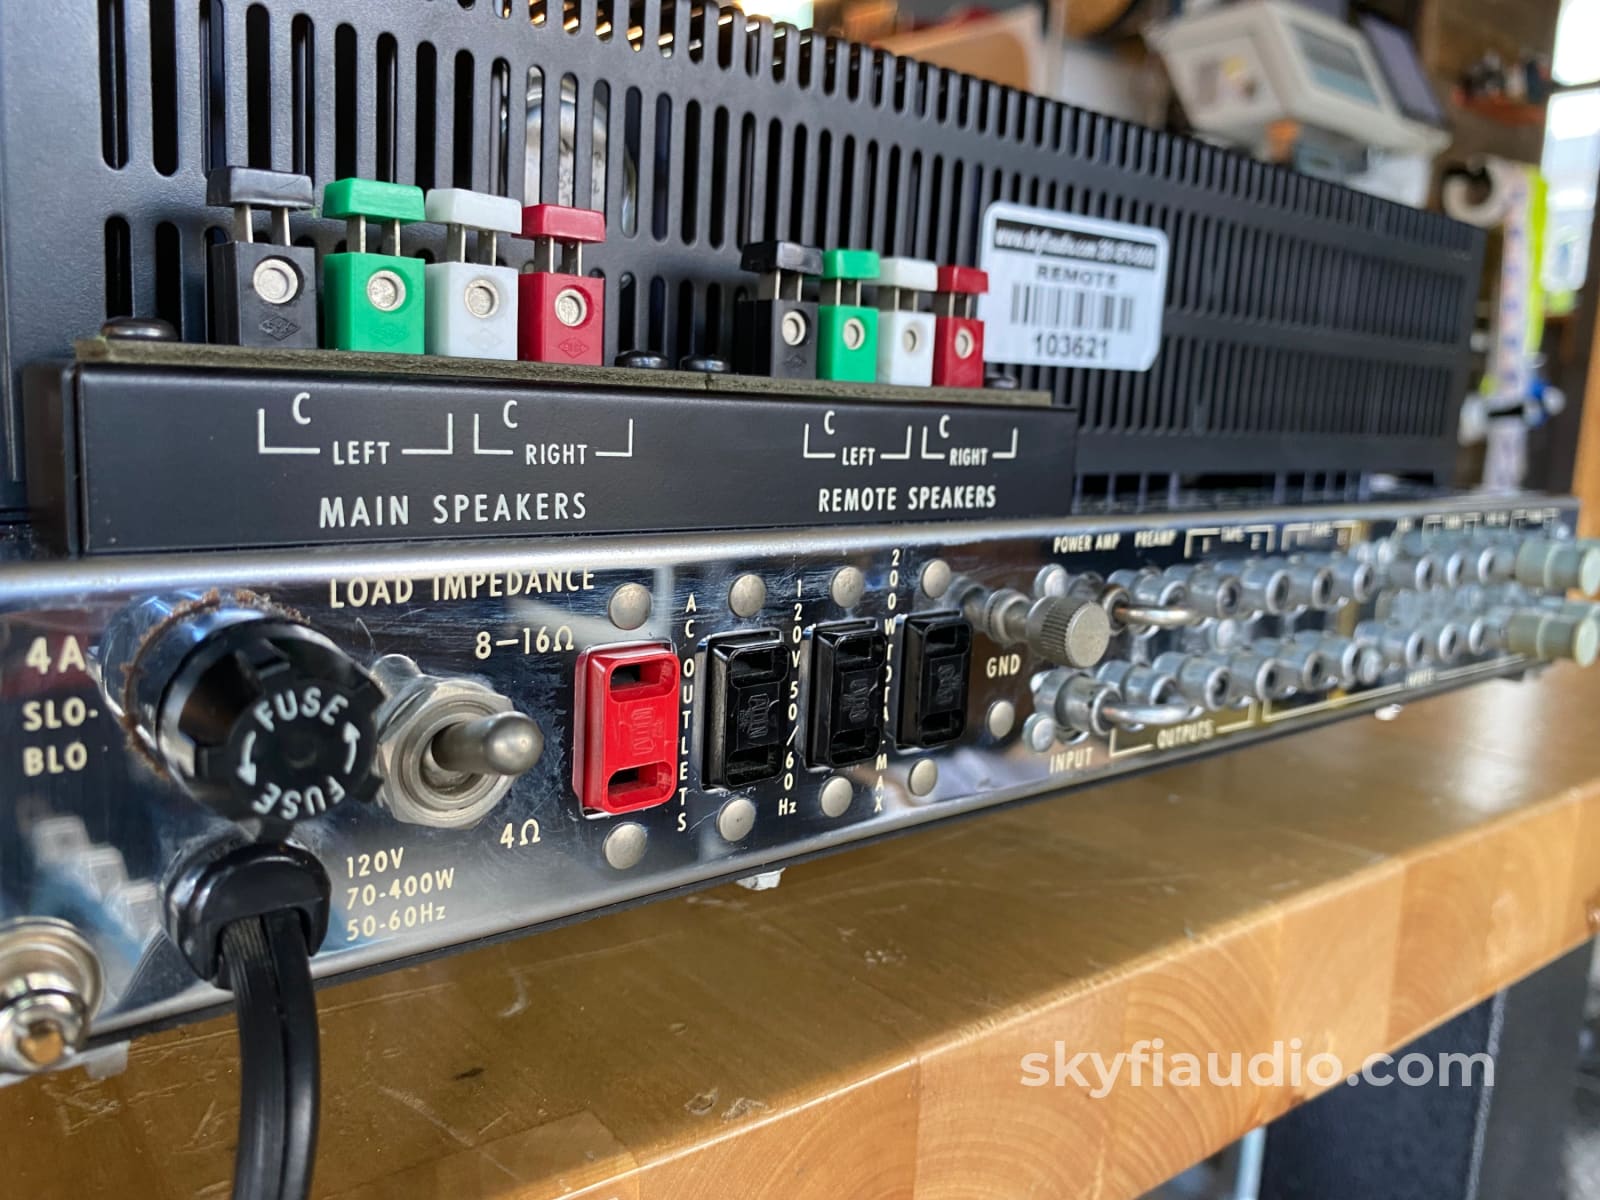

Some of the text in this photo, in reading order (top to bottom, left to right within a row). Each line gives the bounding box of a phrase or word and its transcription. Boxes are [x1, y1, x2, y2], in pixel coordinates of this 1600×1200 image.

[1037, 265, 1118, 287] REMOTE
[1034, 333, 1110, 359] 103621
[292, 392, 311, 425] C
[503, 400, 518, 428] C
[824, 410, 836, 435] C
[939, 414, 950, 438] C
[333, 440, 390, 466] LEFT
[525, 443, 588, 466] RIGHT
[841, 447, 875, 466] LEFT
[949, 447, 989, 466] RIGHT
[319, 492, 587, 529] MAIN SPEAKERS
[818, 484, 996, 513] REMOTE SPEAKERS
[1053, 532, 1121, 554] POWER AMP
[1134, 528, 1178, 548] PREAMP
[329, 567, 595, 609] LOAD IMPEDANCE
[25, 635, 87, 675] 4A
[986, 654, 1021, 679] GND
[22, 696, 99, 731] SLO-
[253, 685, 349, 732] FUSE
[677, 657, 695, 833] OUTLETS
[1156, 719, 1216, 749] OUTPUTS
[22, 741, 88, 777] BLO
[1050, 747, 1093, 774] INPUT
[252, 775, 346, 820] FUSE
[346, 847, 405, 879] 120V
[346, 867, 455, 909] 70-400W
[346, 902, 447, 942] 50-60Hz
